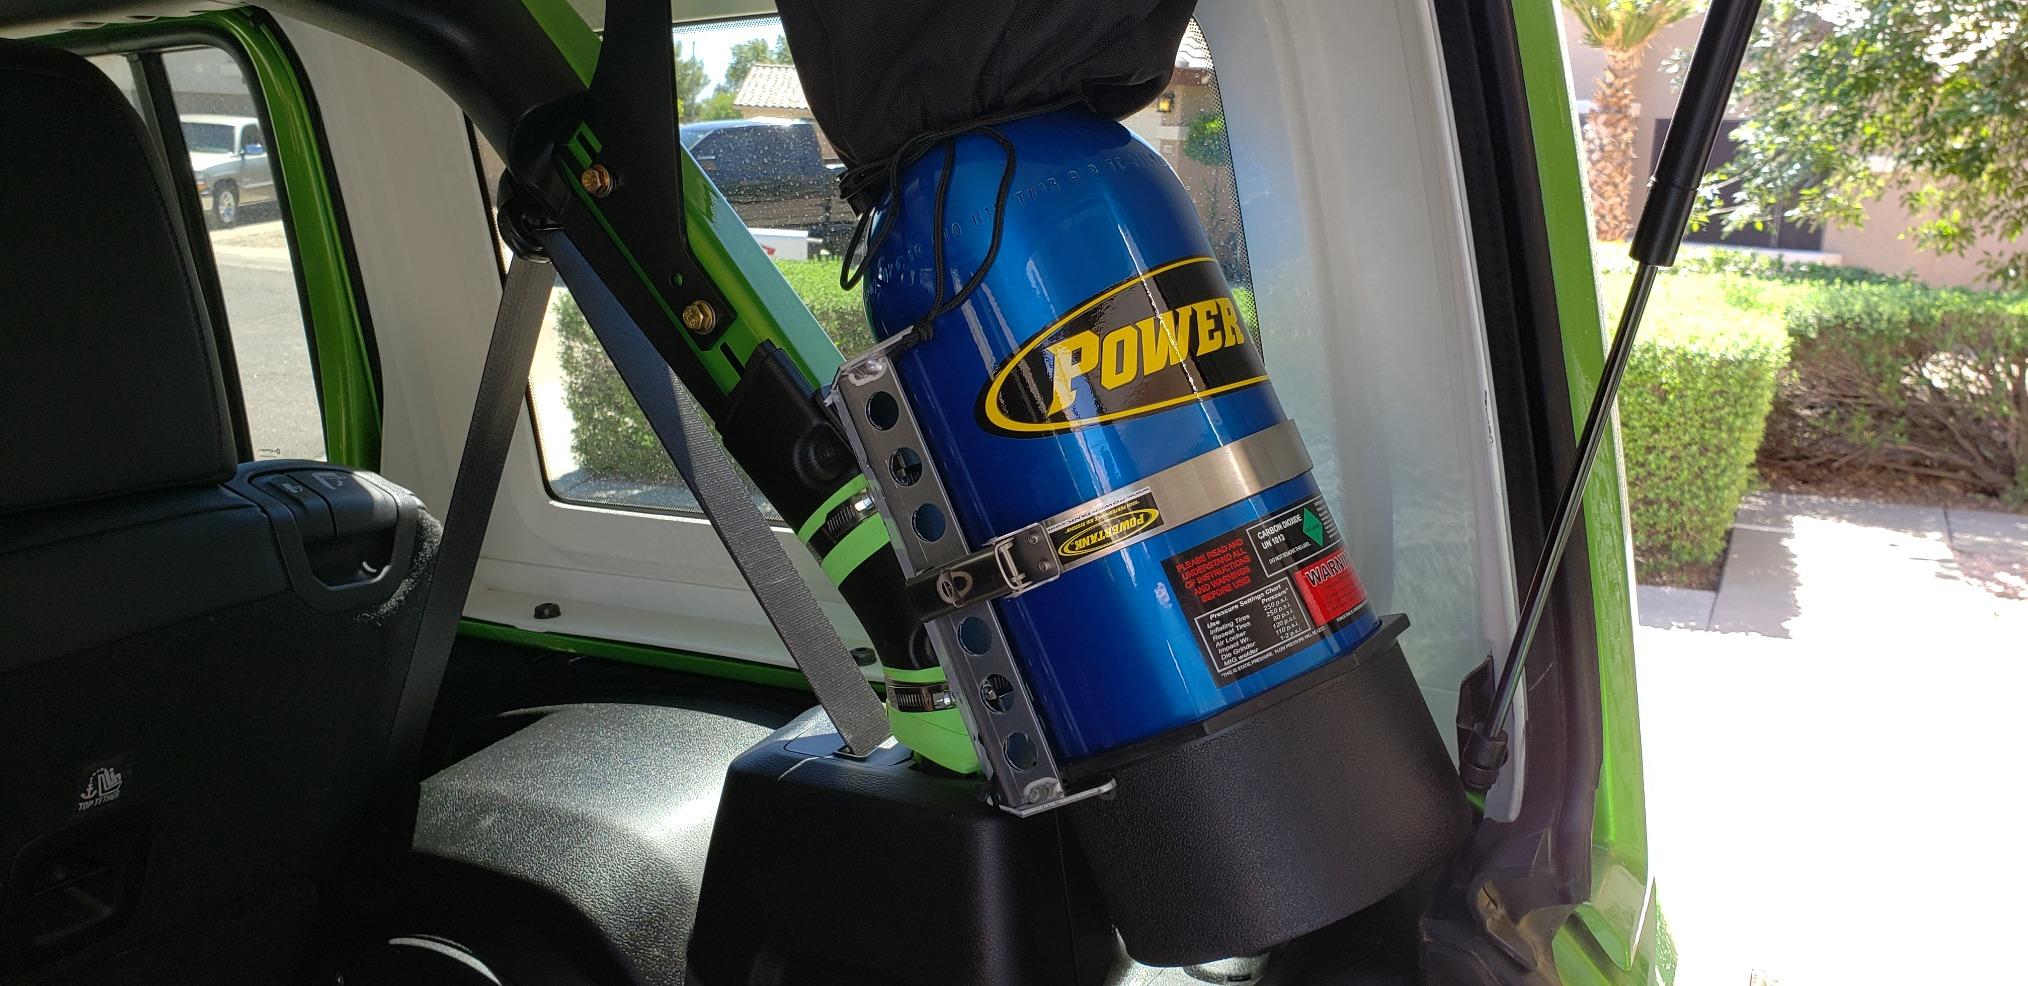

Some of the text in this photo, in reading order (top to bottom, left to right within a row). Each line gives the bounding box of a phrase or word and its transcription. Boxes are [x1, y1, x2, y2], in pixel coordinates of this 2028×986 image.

[1046, 297, 1245, 417] POWER
[1074, 513, 1145, 551] POWERTANK
[1257, 522, 1283, 540] CARBON
[1281, 513, 1302, 529] DIOXIDE
[1261, 533, 1286, 550] UN 1013
[1176, 538, 1243, 572] PLEASE READ AND
[1181, 548, 1247, 580] UNDERSTAND ALL
[1184, 556, 1251, 589] OF INSTRUCTIONS
[1194, 565, 1251, 596] AND WARNINGS
[1200, 584, 1233, 603] BEFORE
[1209, 584, 1281, 620] Pressure Settings Chart
[1206, 620, 1220, 629] Use
[1209, 621, 1234, 636] Inflating
[1235, 614, 1250, 624] Tires
[1263, 601, 1275, 611] 250
[1212, 627, 1235, 642] Reseat
[1235, 621, 1251, 631] Tires
[1266, 607, 1278, 617] 250
[1215, 640, 1225, 648] Air
[1225, 630, 1247, 644] Locker
[1272, 614, 1281, 622] 80
[1218, 641, 1239, 654] Impact
[1239, 636, 1251, 644] Wr.
[1272, 621, 1284, 629] 120
[1220, 652, 1232, 661] Die
[1232, 641, 1256, 655] Grinder
[1275, 627, 1286, 635] 110
[1223, 656, 1238, 667] MIG
[1238, 647, 1259, 660] welder
[78, 800, 94, 811] TOP
